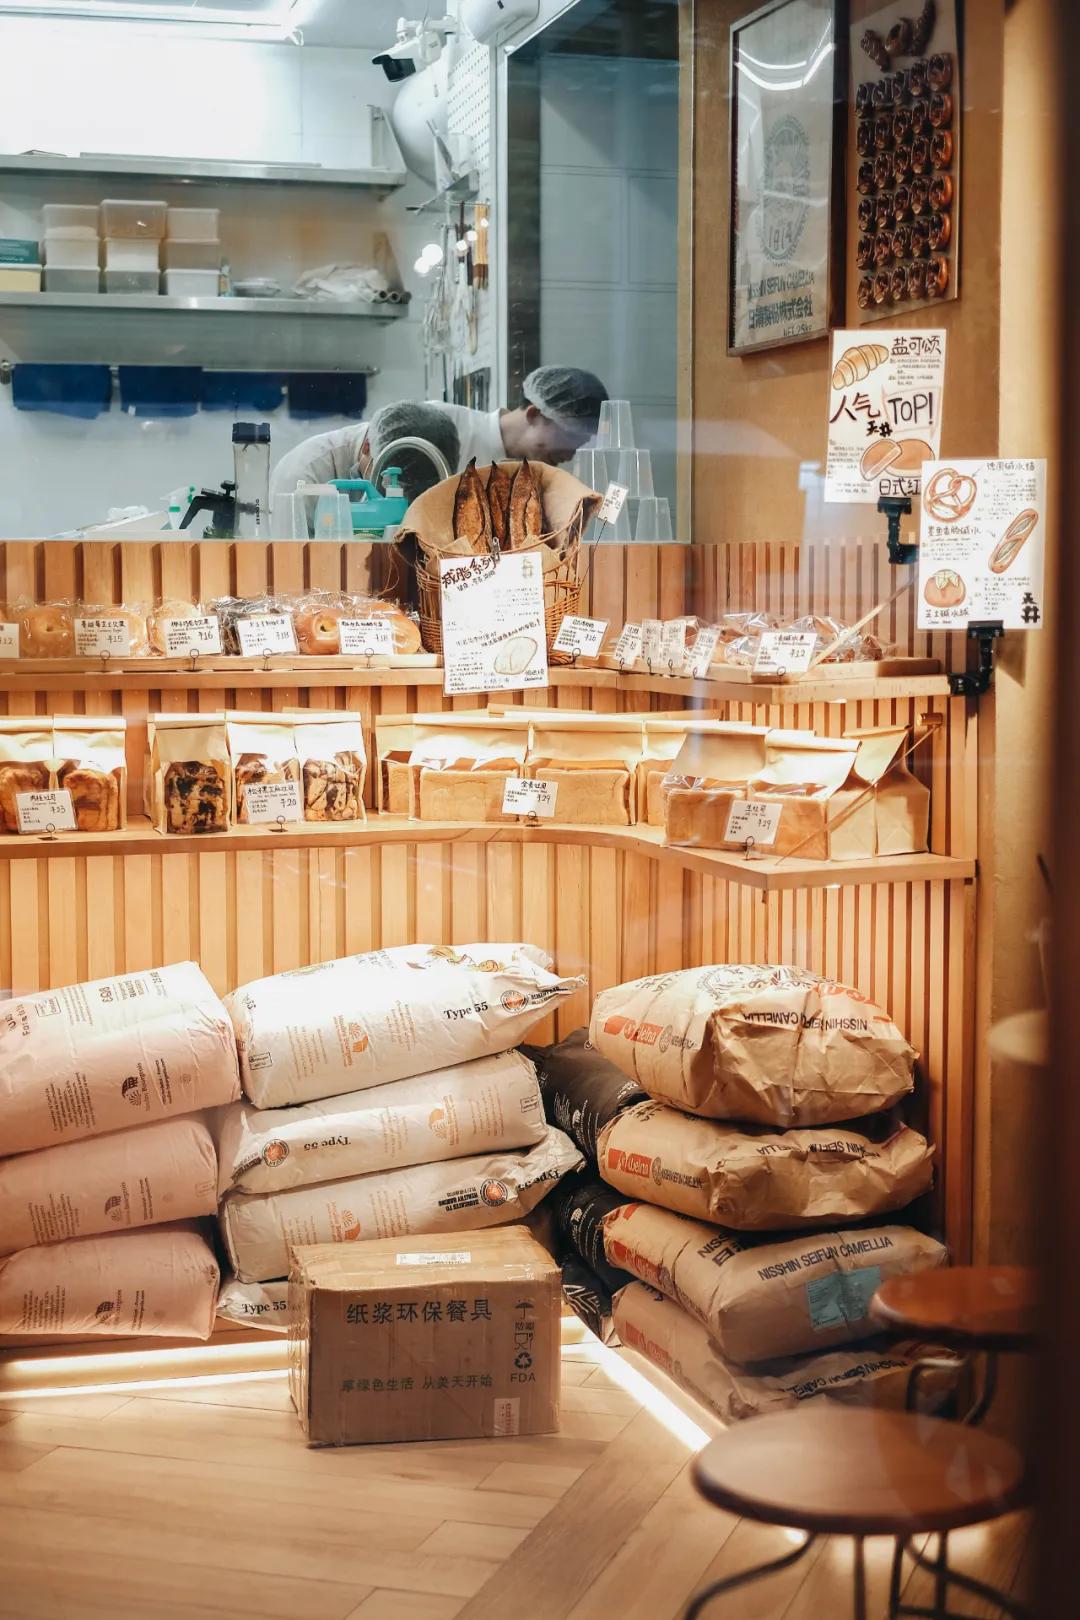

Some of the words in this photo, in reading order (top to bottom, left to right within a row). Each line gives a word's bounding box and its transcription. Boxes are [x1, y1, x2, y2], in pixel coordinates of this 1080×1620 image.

[891, 336, 942, 356] 盐可颂
[829, 393, 881, 423] 人气
[888, 393, 934, 425] TOP!
[443, 1005, 473, 1021] Type
[474, 1000, 489, 1014] 55
[825, 1017, 868, 1031] NISSHIN
[303, 1142, 320, 1152] 55
[321, 1135, 352, 1149] Type
[534, 1168, 563, 1185] Type
[757, 1260, 802, 1282] NISSHIN
[801, 1247, 838, 1268] SEIFUN
[840, 1236, 894, 1257] CAMELLIA
[241, 1303, 270, 1314] Type
[272, 1301, 287, 1311] 55
[346, 1299, 493, 1325] 纸浆环保餐具
[510, 1373, 537, 1384] FDA
